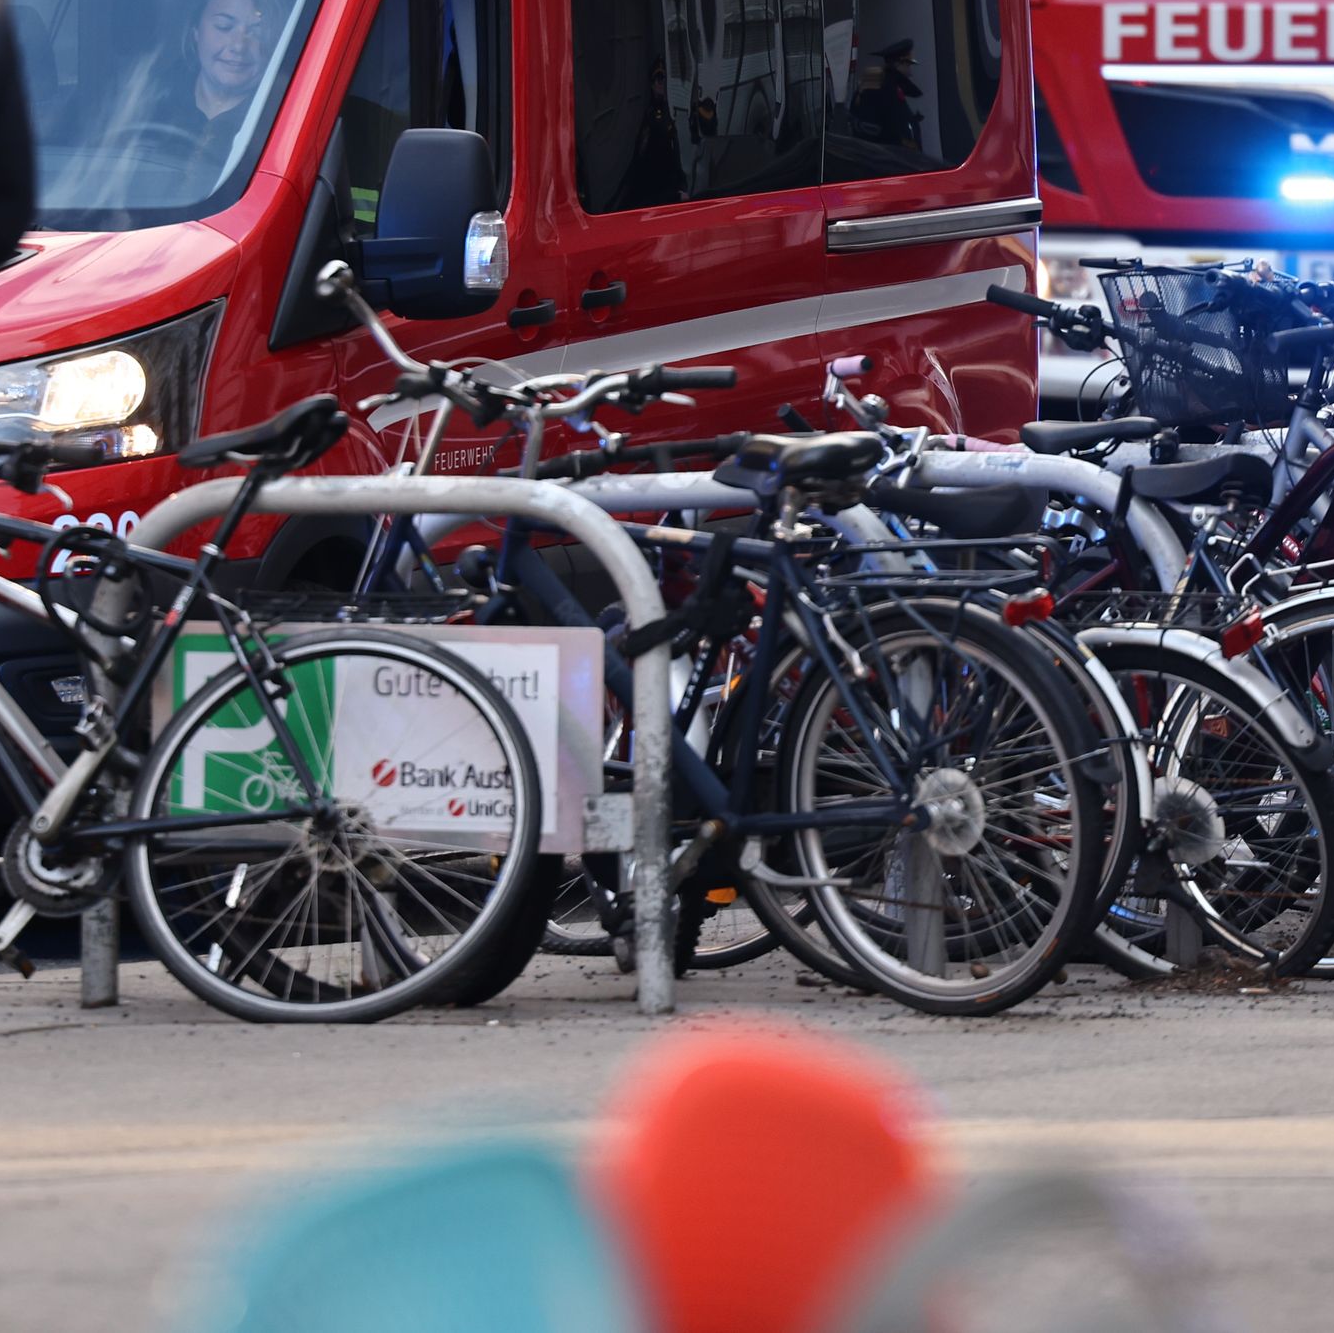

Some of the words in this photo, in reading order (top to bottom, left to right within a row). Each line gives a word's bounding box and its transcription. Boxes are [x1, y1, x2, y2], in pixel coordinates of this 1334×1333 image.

[434, 444, 495, 471] FEUERWEHR
[373, 666, 443, 698] Gute
[400, 761, 456, 788] Bank
[459, 762, 513, 788] Aust
[468, 799, 515, 818] UniCre
